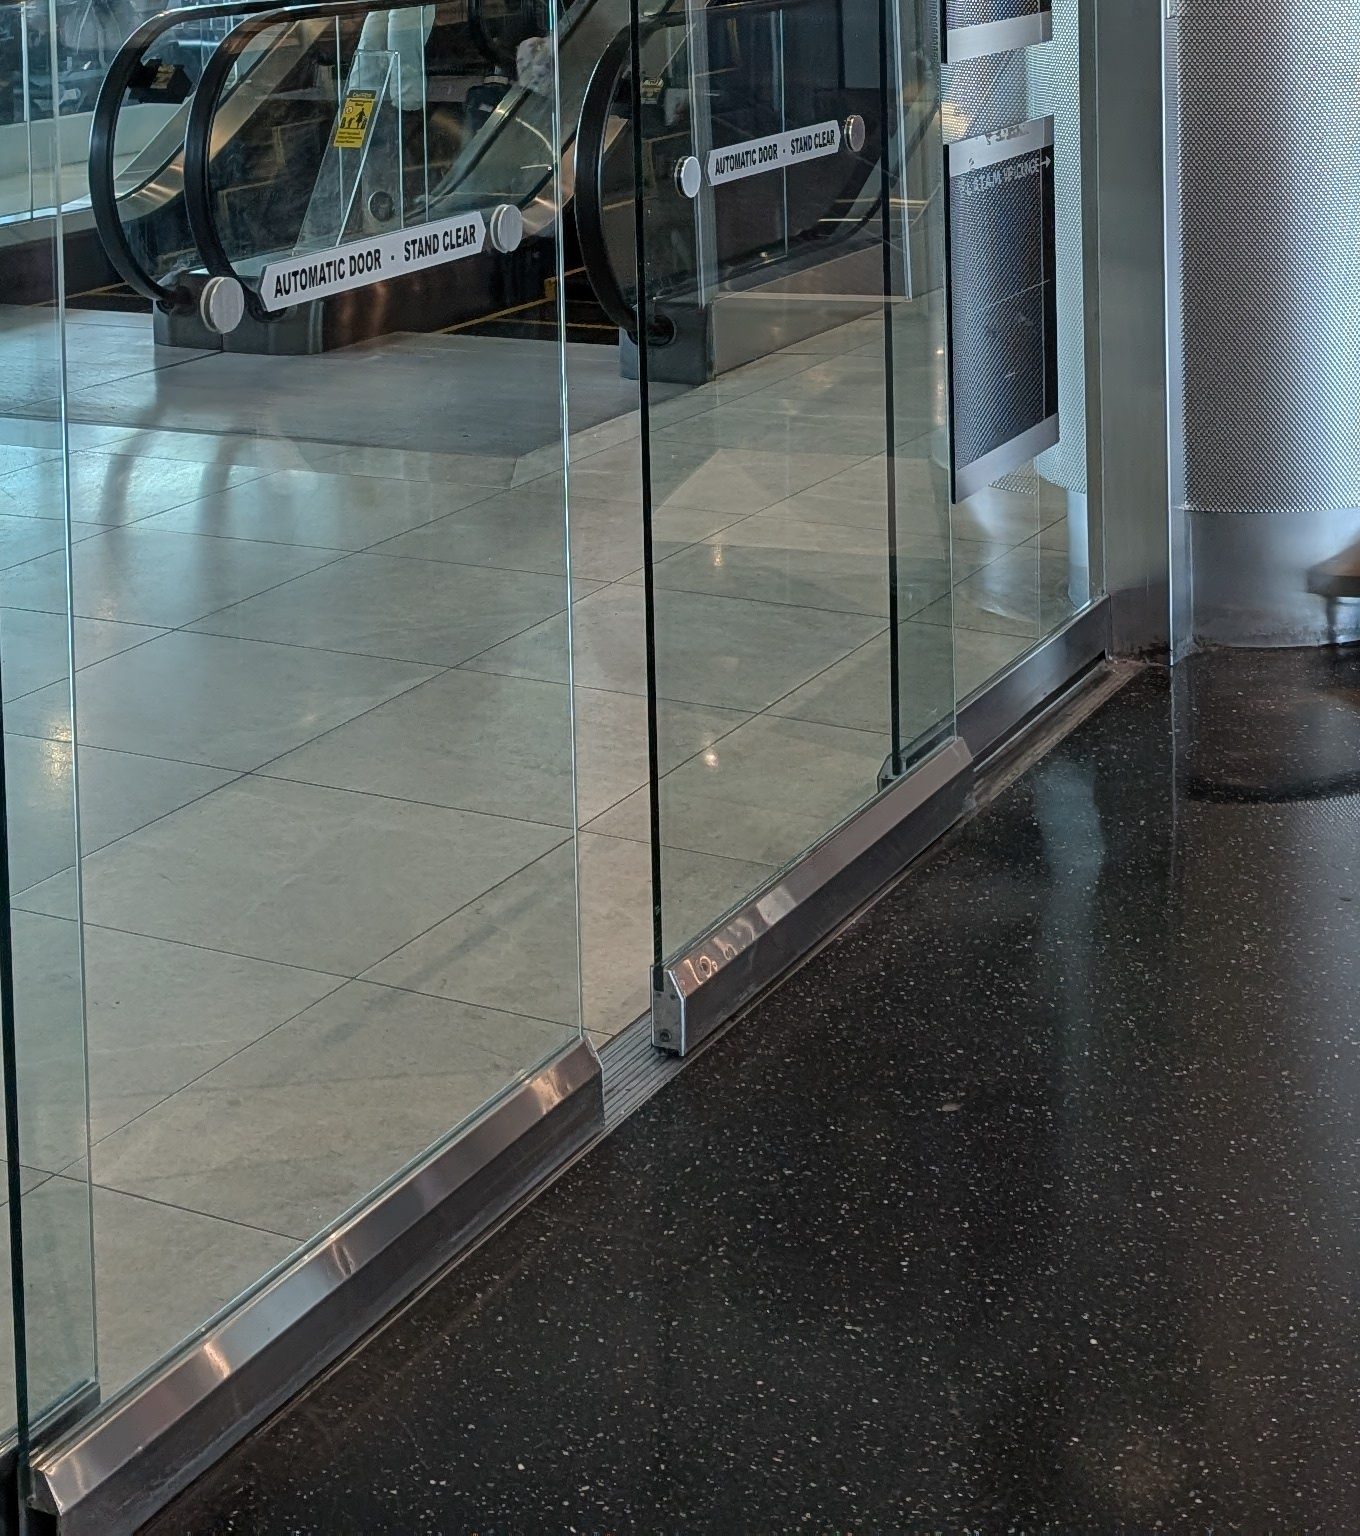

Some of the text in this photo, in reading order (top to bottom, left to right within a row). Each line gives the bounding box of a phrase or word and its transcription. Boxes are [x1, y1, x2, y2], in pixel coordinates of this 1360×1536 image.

[715, 130, 835, 176] AUTOMATIC DOOR STAND CLEAR
[274, 224, 476, 298] AUTOMATIC DOOR STAND CLEAR
